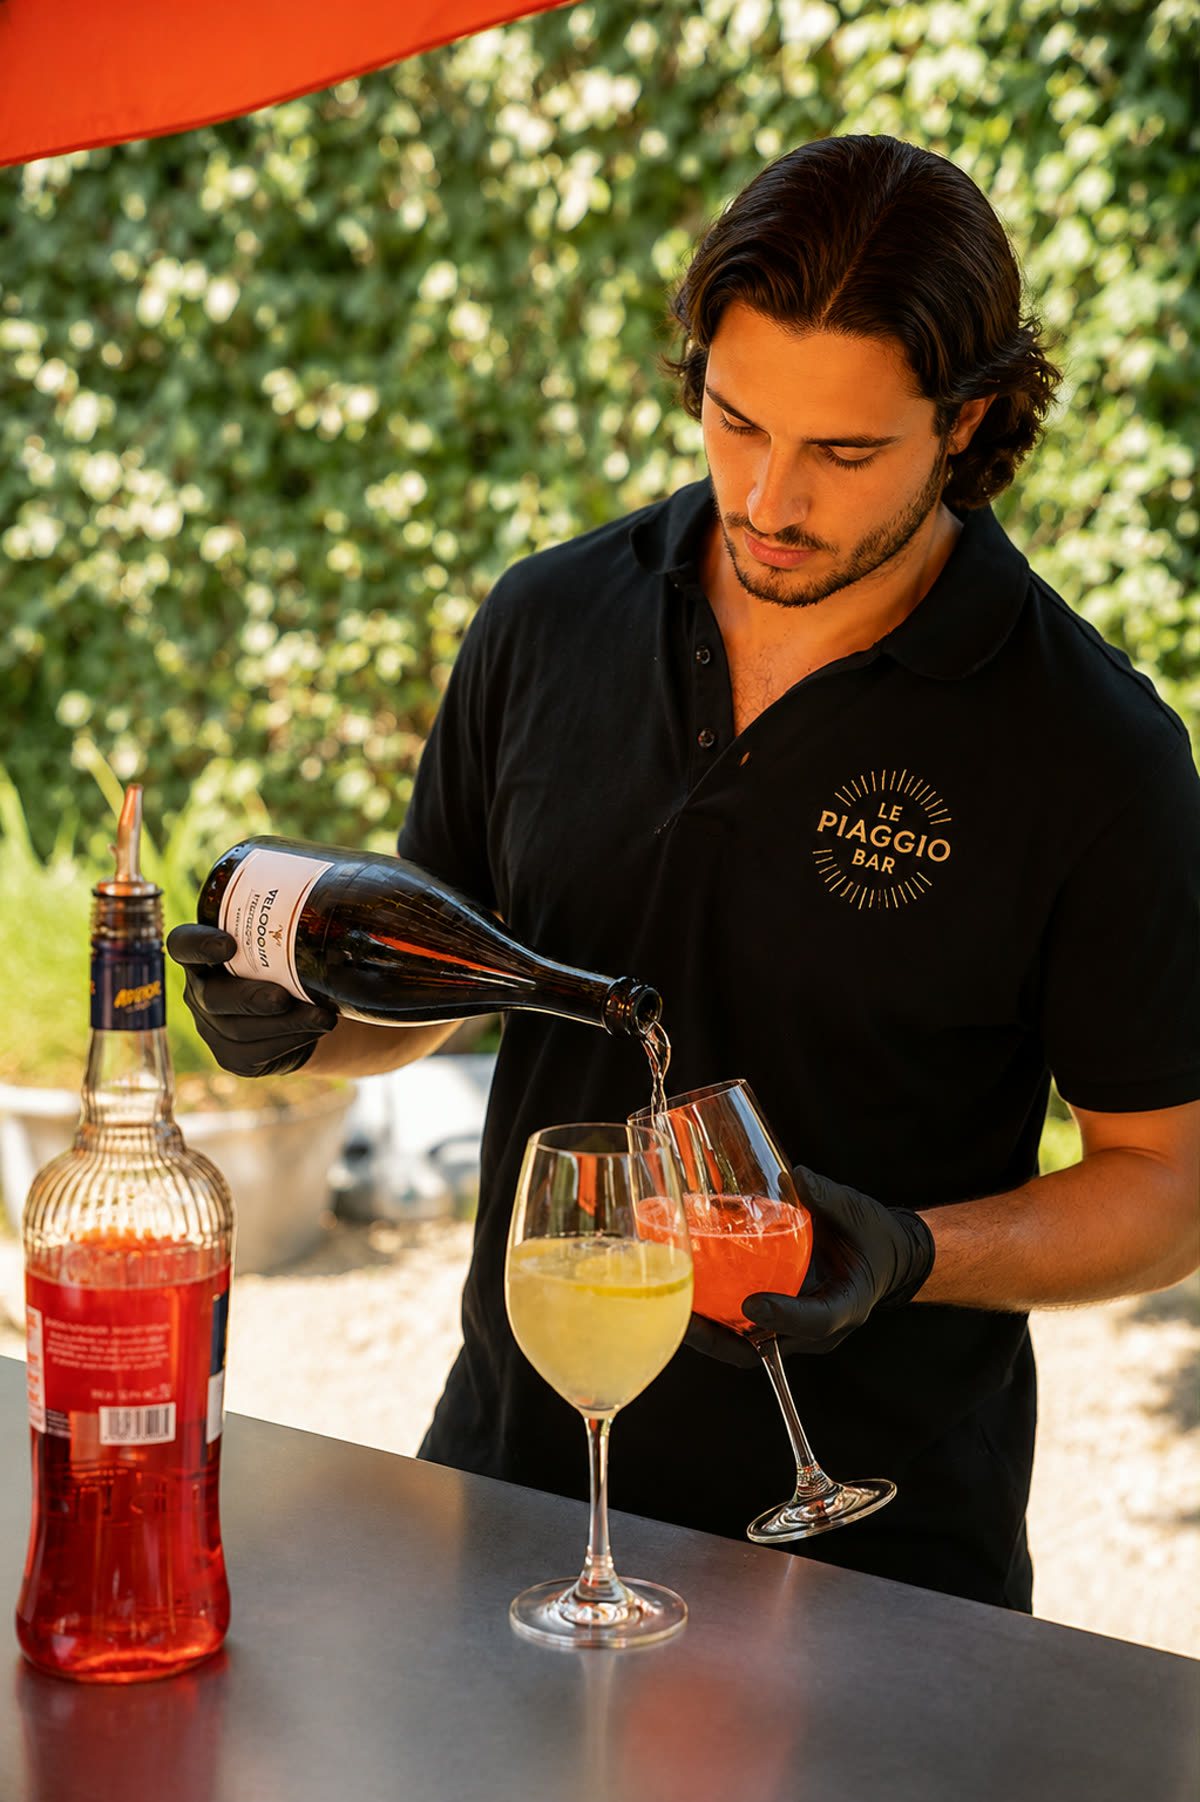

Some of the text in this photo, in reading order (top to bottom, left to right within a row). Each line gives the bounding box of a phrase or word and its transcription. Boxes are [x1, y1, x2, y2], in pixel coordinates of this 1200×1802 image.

[877, 802, 903, 822] LE
[816, 810, 951, 862] PIAGGIO
[851, 848, 896, 875] BAR
